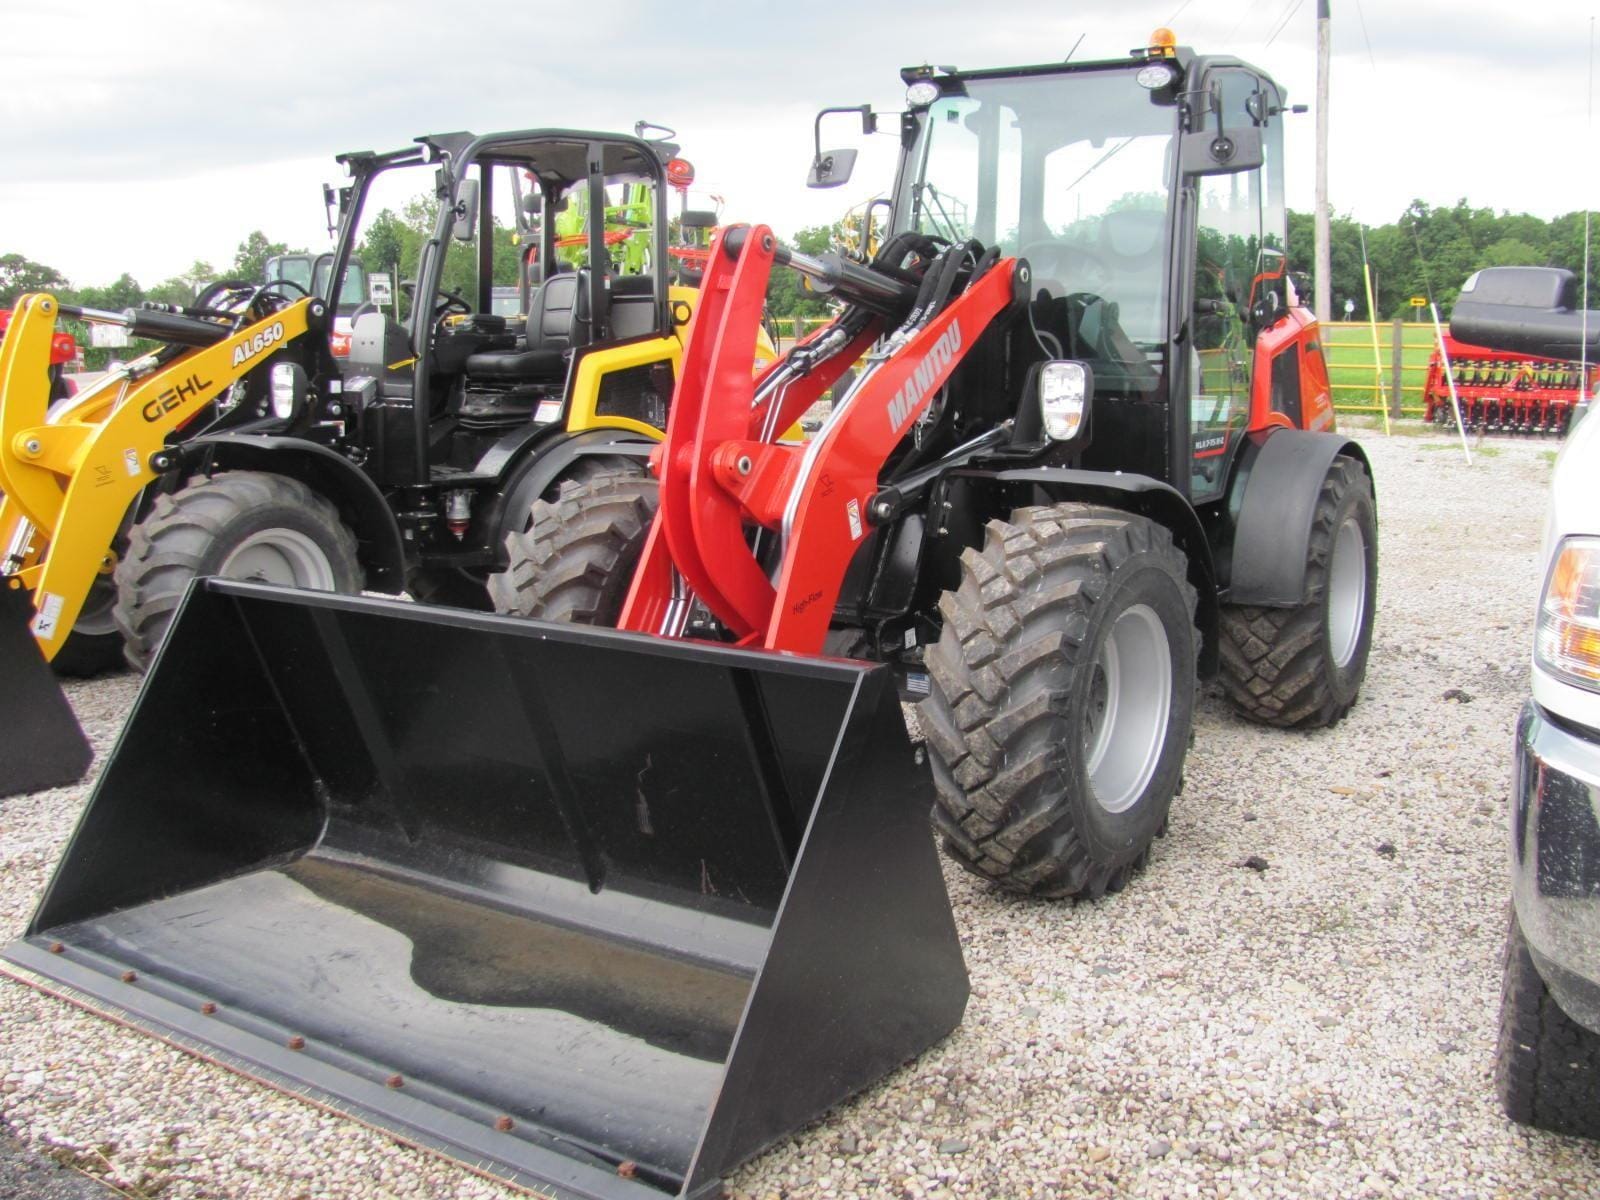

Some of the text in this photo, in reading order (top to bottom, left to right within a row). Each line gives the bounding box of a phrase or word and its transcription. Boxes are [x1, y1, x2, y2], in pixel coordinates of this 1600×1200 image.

[232, 321, 284, 368] AL650
[142, 374, 213, 422] GEHL
[887, 318, 962, 434] MANITOU
